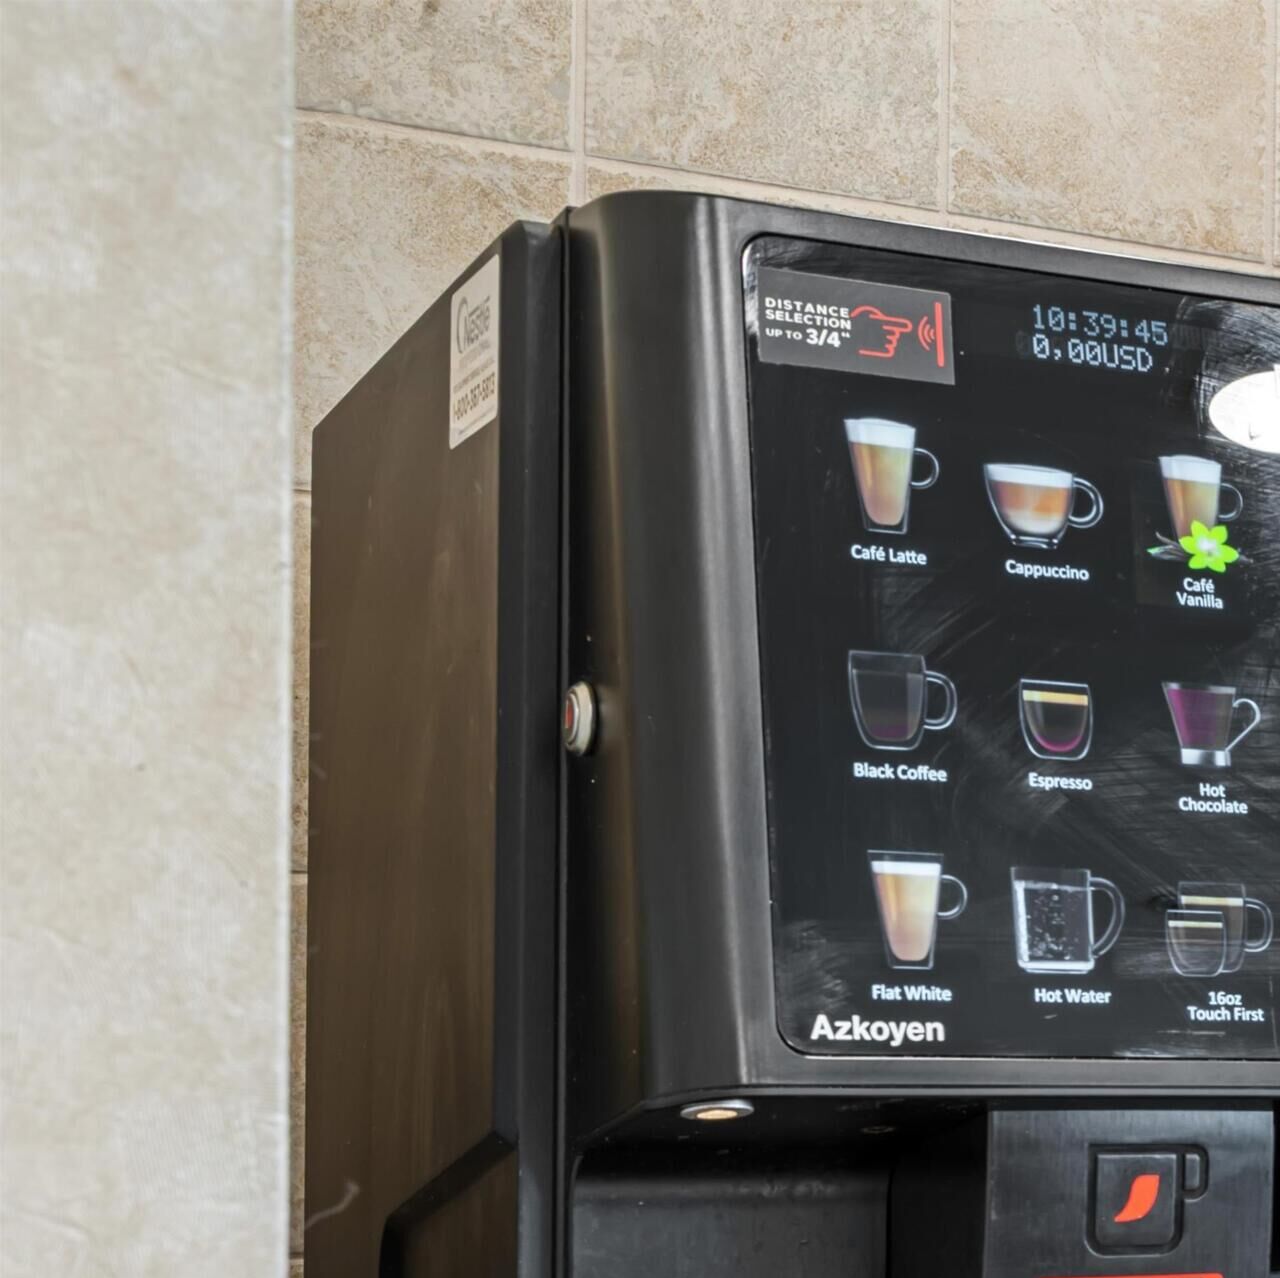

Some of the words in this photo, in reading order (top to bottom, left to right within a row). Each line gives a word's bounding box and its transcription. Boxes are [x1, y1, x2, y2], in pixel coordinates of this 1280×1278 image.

[765, 297, 849, 318] DISTANCE
[766, 309, 851, 330] SELECTION
[1033, 304, 1168, 346] 10:39:45
[765, 328, 783, 338] UP
[786, 331, 802, 340] TO
[851, 544, 886, 563] Café
[889, 547, 928, 565] Latte
[1005, 560, 1090, 581] Cappuccino
[1183, 577, 1215, 594] Café
[1176, 592, 1223, 609] Vanilla
[853, 762, 897, 781] Black
[899, 762, 948, 782] Coffee
[1028, 772, 1093, 792] Espresso
[1199, 783, 1226, 798] Hot
[1178, 796, 1248, 815] Chocolate
[871, 984, 902, 1001] Flat
[904, 984, 952, 1002] White
[1034, 987, 1064, 1004] Hot
[1065, 987, 1112, 1005] Water
[1207, 990, 1243, 1006] 16oz
[1187, 1004, 1229, 1021] Touch
[1231, 1005, 1265, 1022] First
[810, 1013, 945, 1048] Azkoyen
